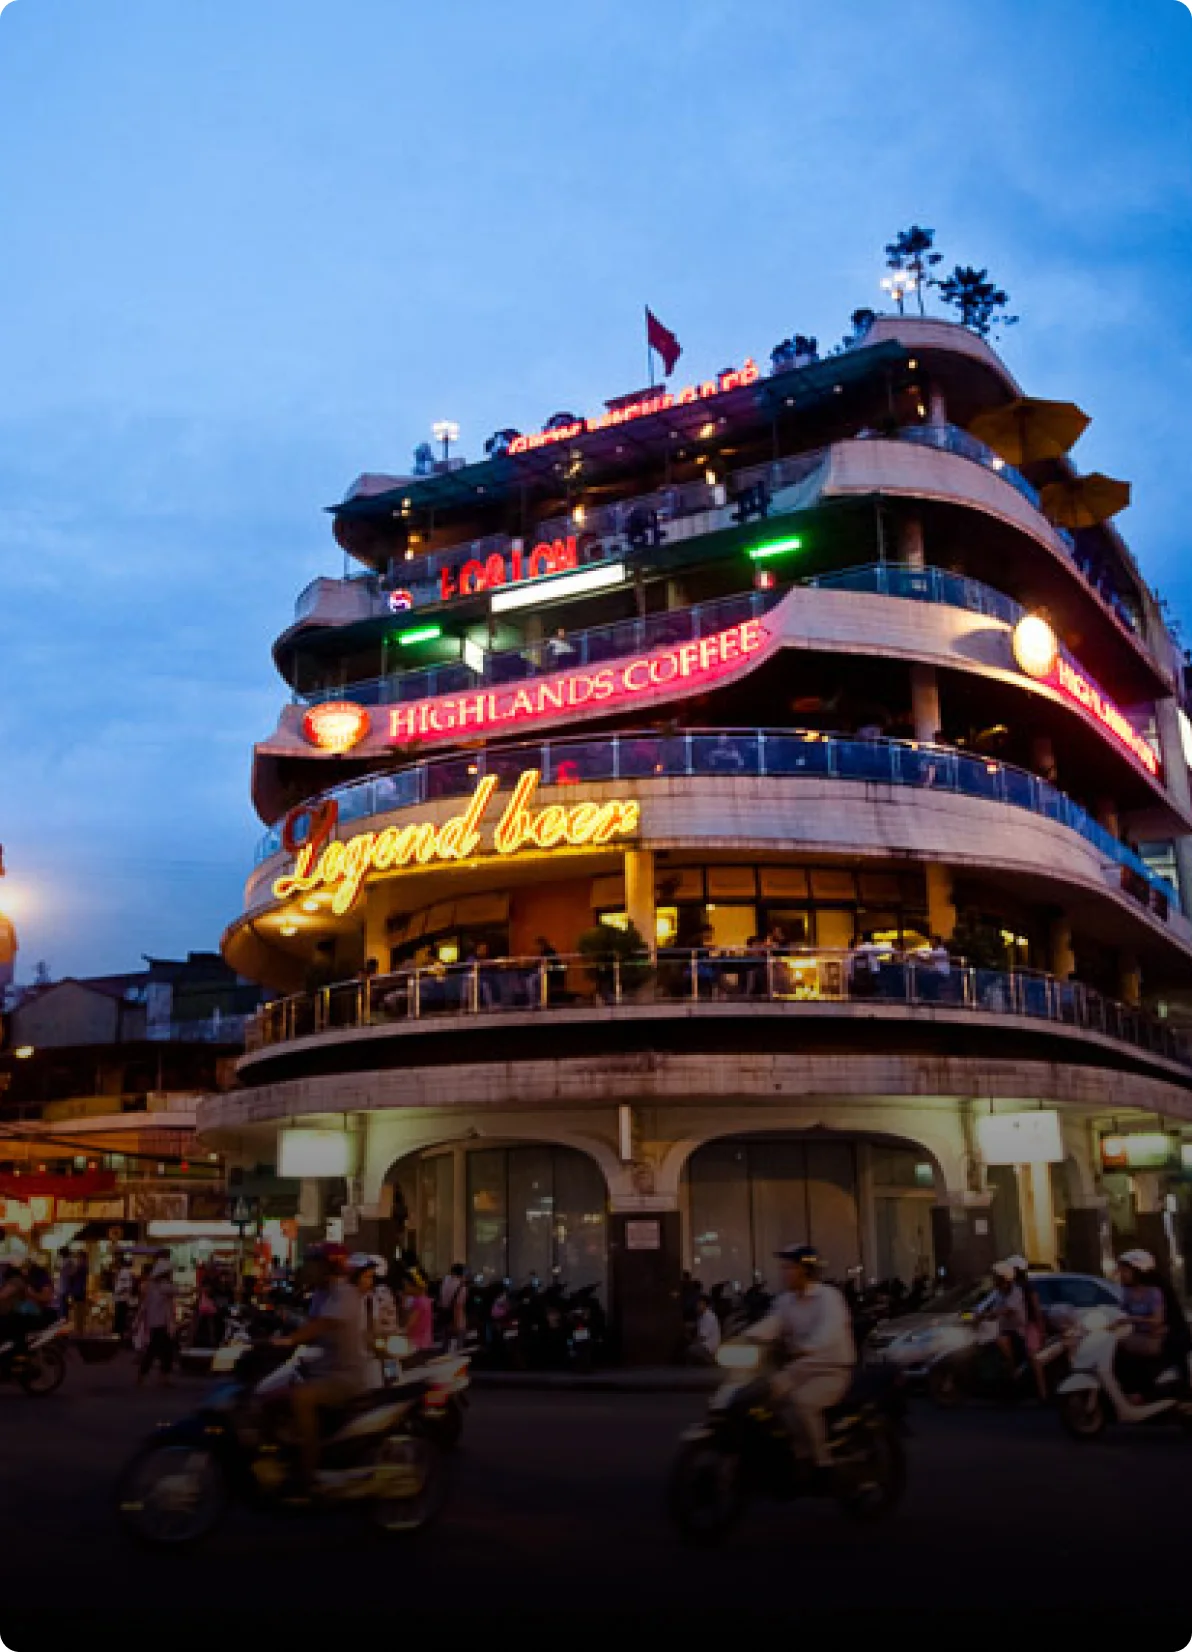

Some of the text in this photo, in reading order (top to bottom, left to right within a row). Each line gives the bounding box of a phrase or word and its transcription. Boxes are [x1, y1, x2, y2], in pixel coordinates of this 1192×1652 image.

[389, 619, 761, 738] HIGHLANDS COFFEE
[271, 773, 499, 914] Legend
